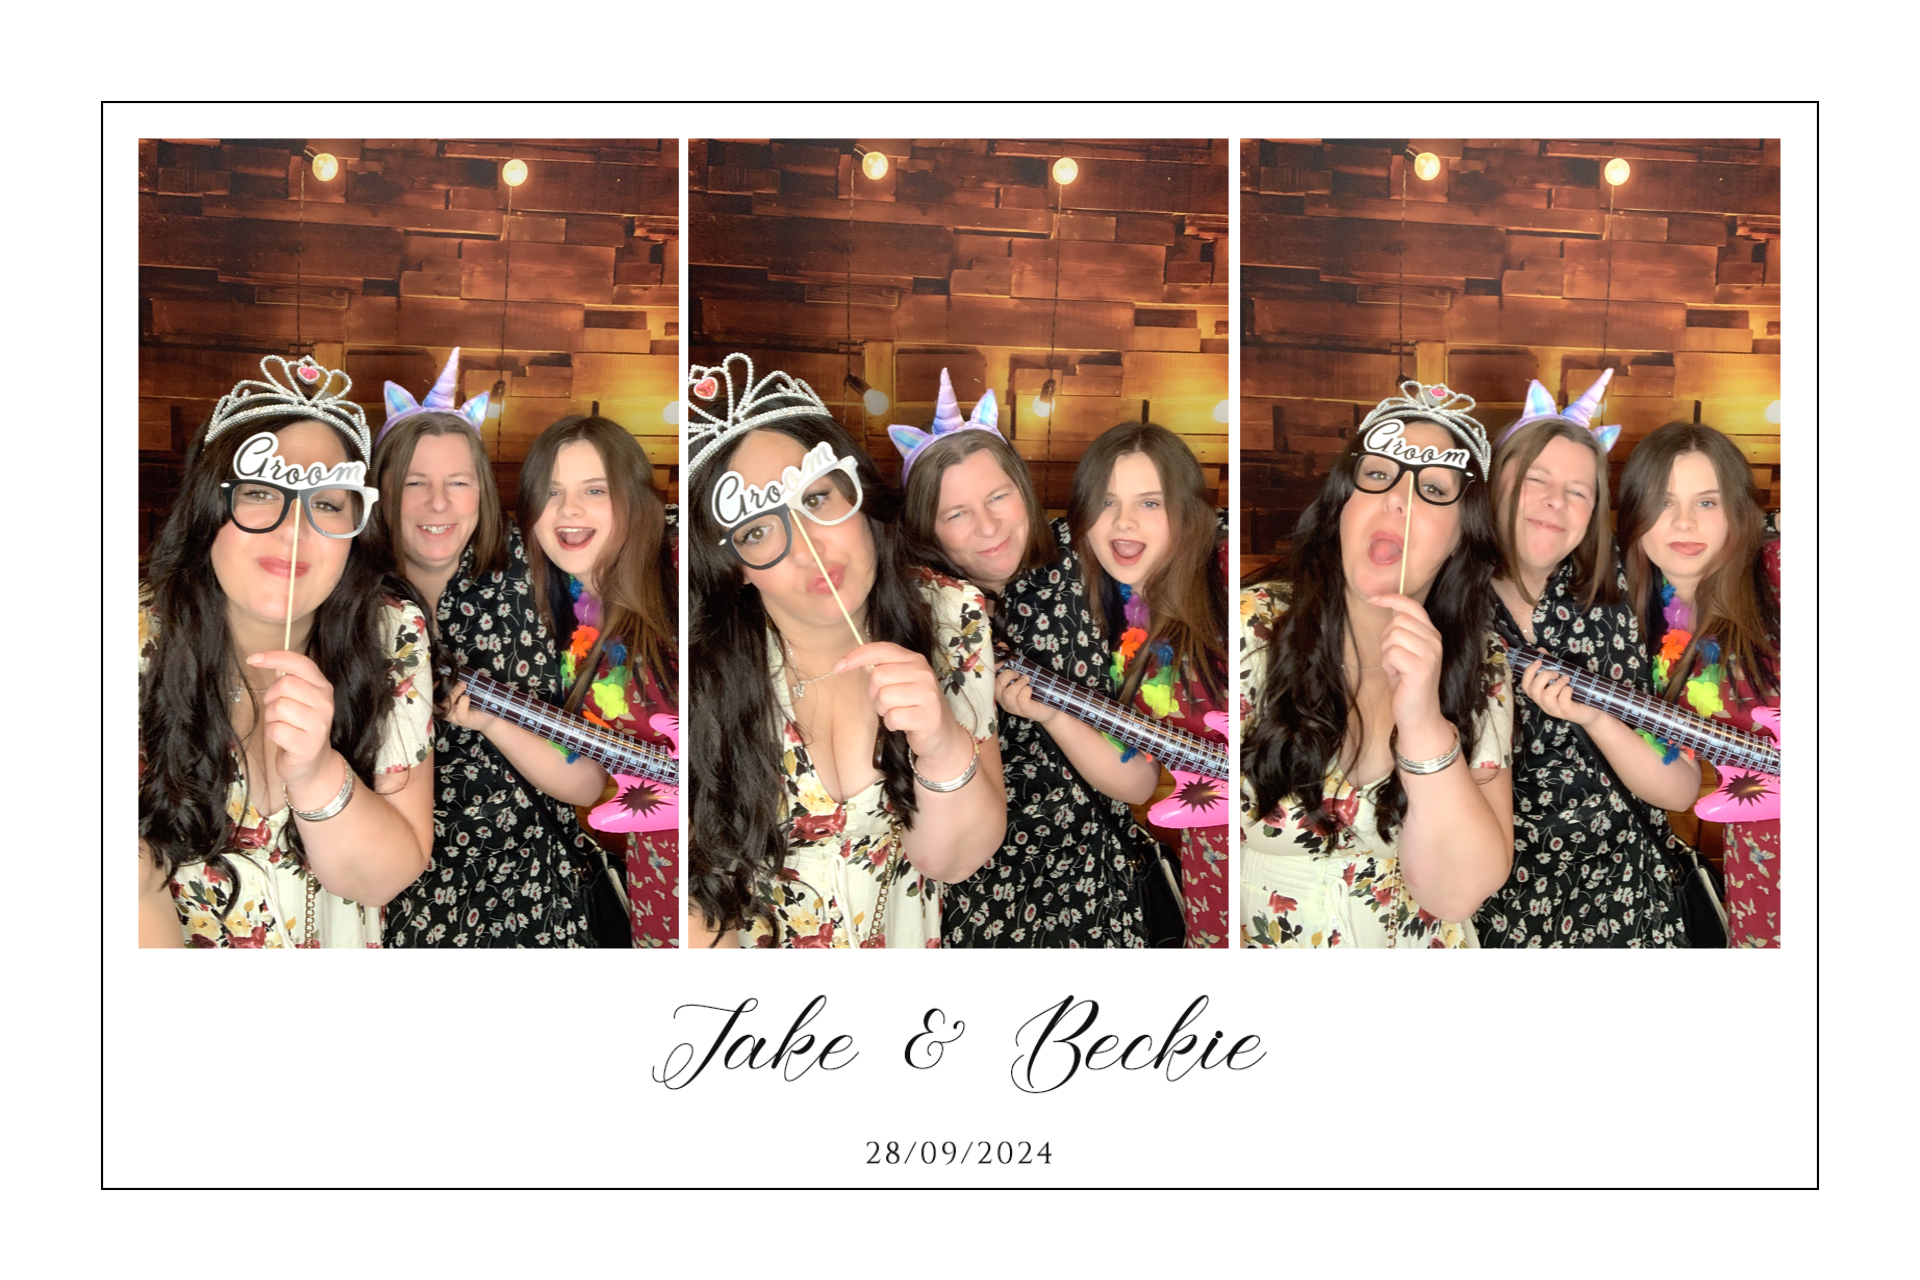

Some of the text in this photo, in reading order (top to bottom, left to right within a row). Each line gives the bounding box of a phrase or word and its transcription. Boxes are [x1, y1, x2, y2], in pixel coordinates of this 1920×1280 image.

[236, 436, 361, 486] Groom
[1366, 421, 1466, 466] Groom
[714, 445, 832, 524] Groom
